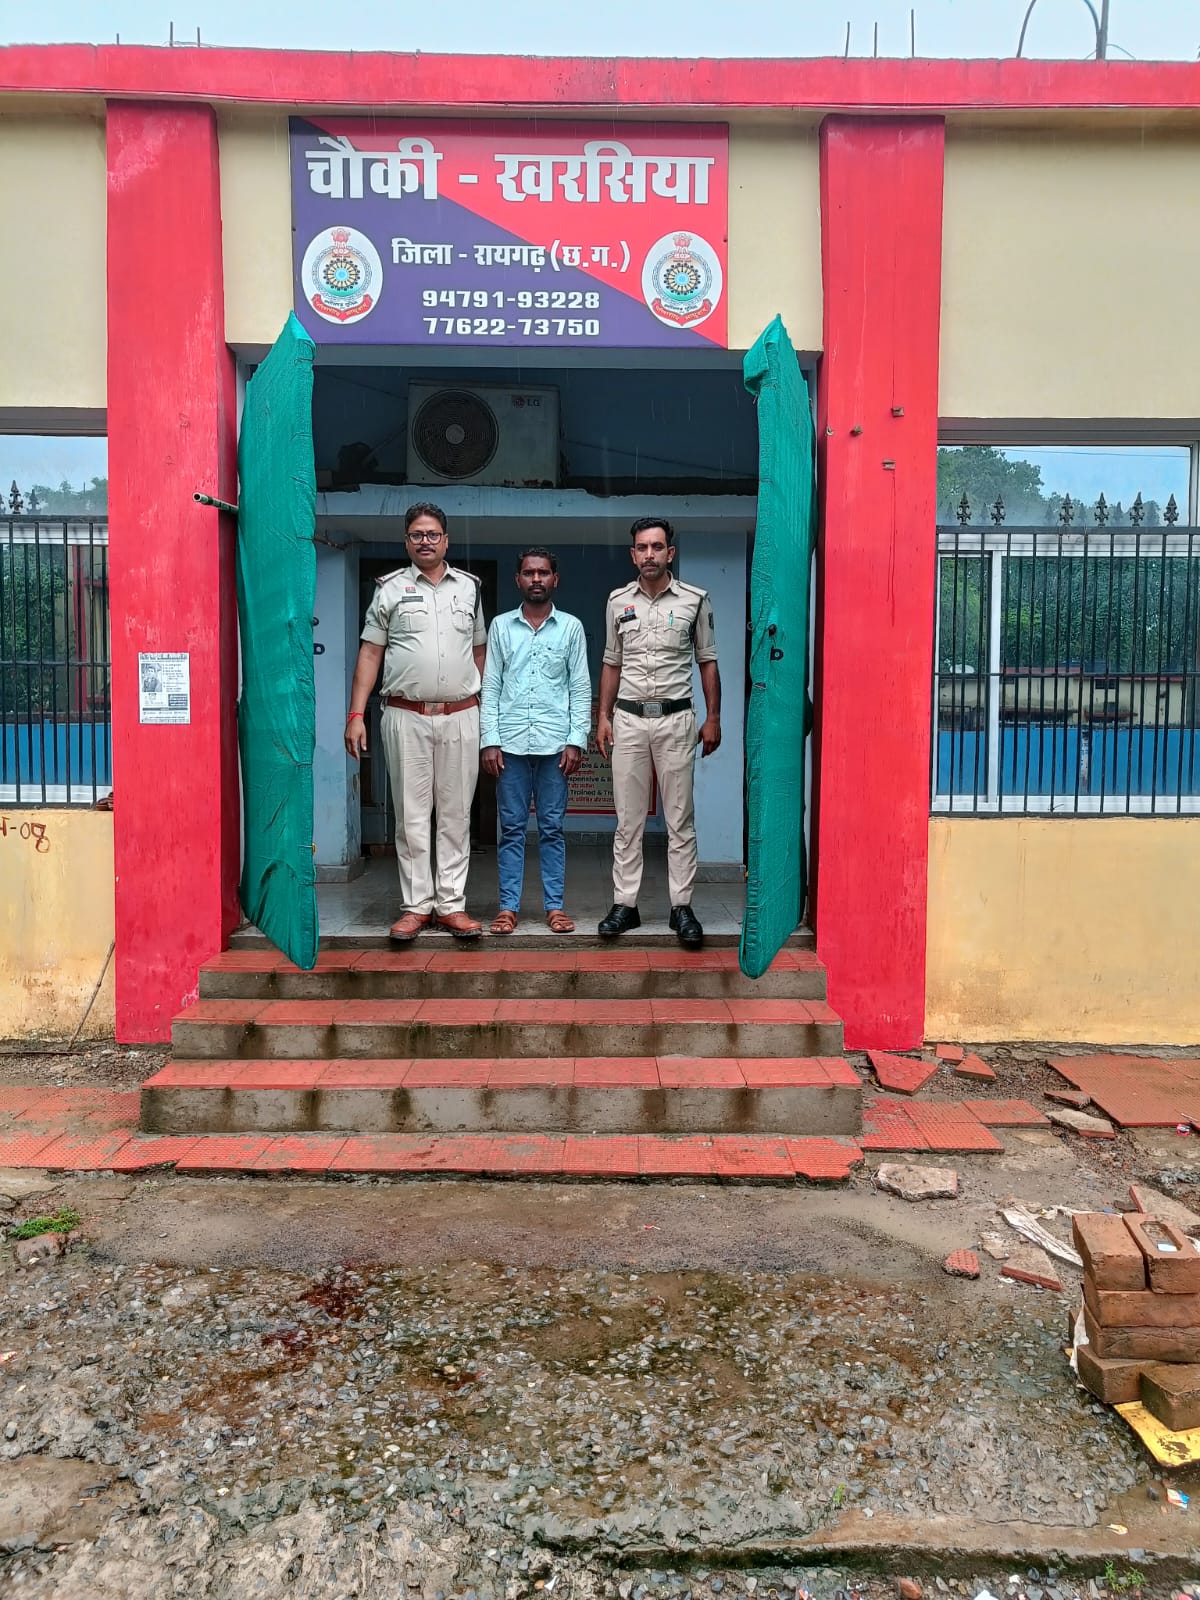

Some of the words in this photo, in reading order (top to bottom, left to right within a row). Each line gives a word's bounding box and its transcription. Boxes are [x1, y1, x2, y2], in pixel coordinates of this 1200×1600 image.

[305, 136, 443, 200] चौकी
[494, 140, 715, 204] खरसिया
[391, 237, 453, 265] जिला
[422, 290, 600, 309] 94791-93228
[423, 317, 600, 336] 77622-73750
